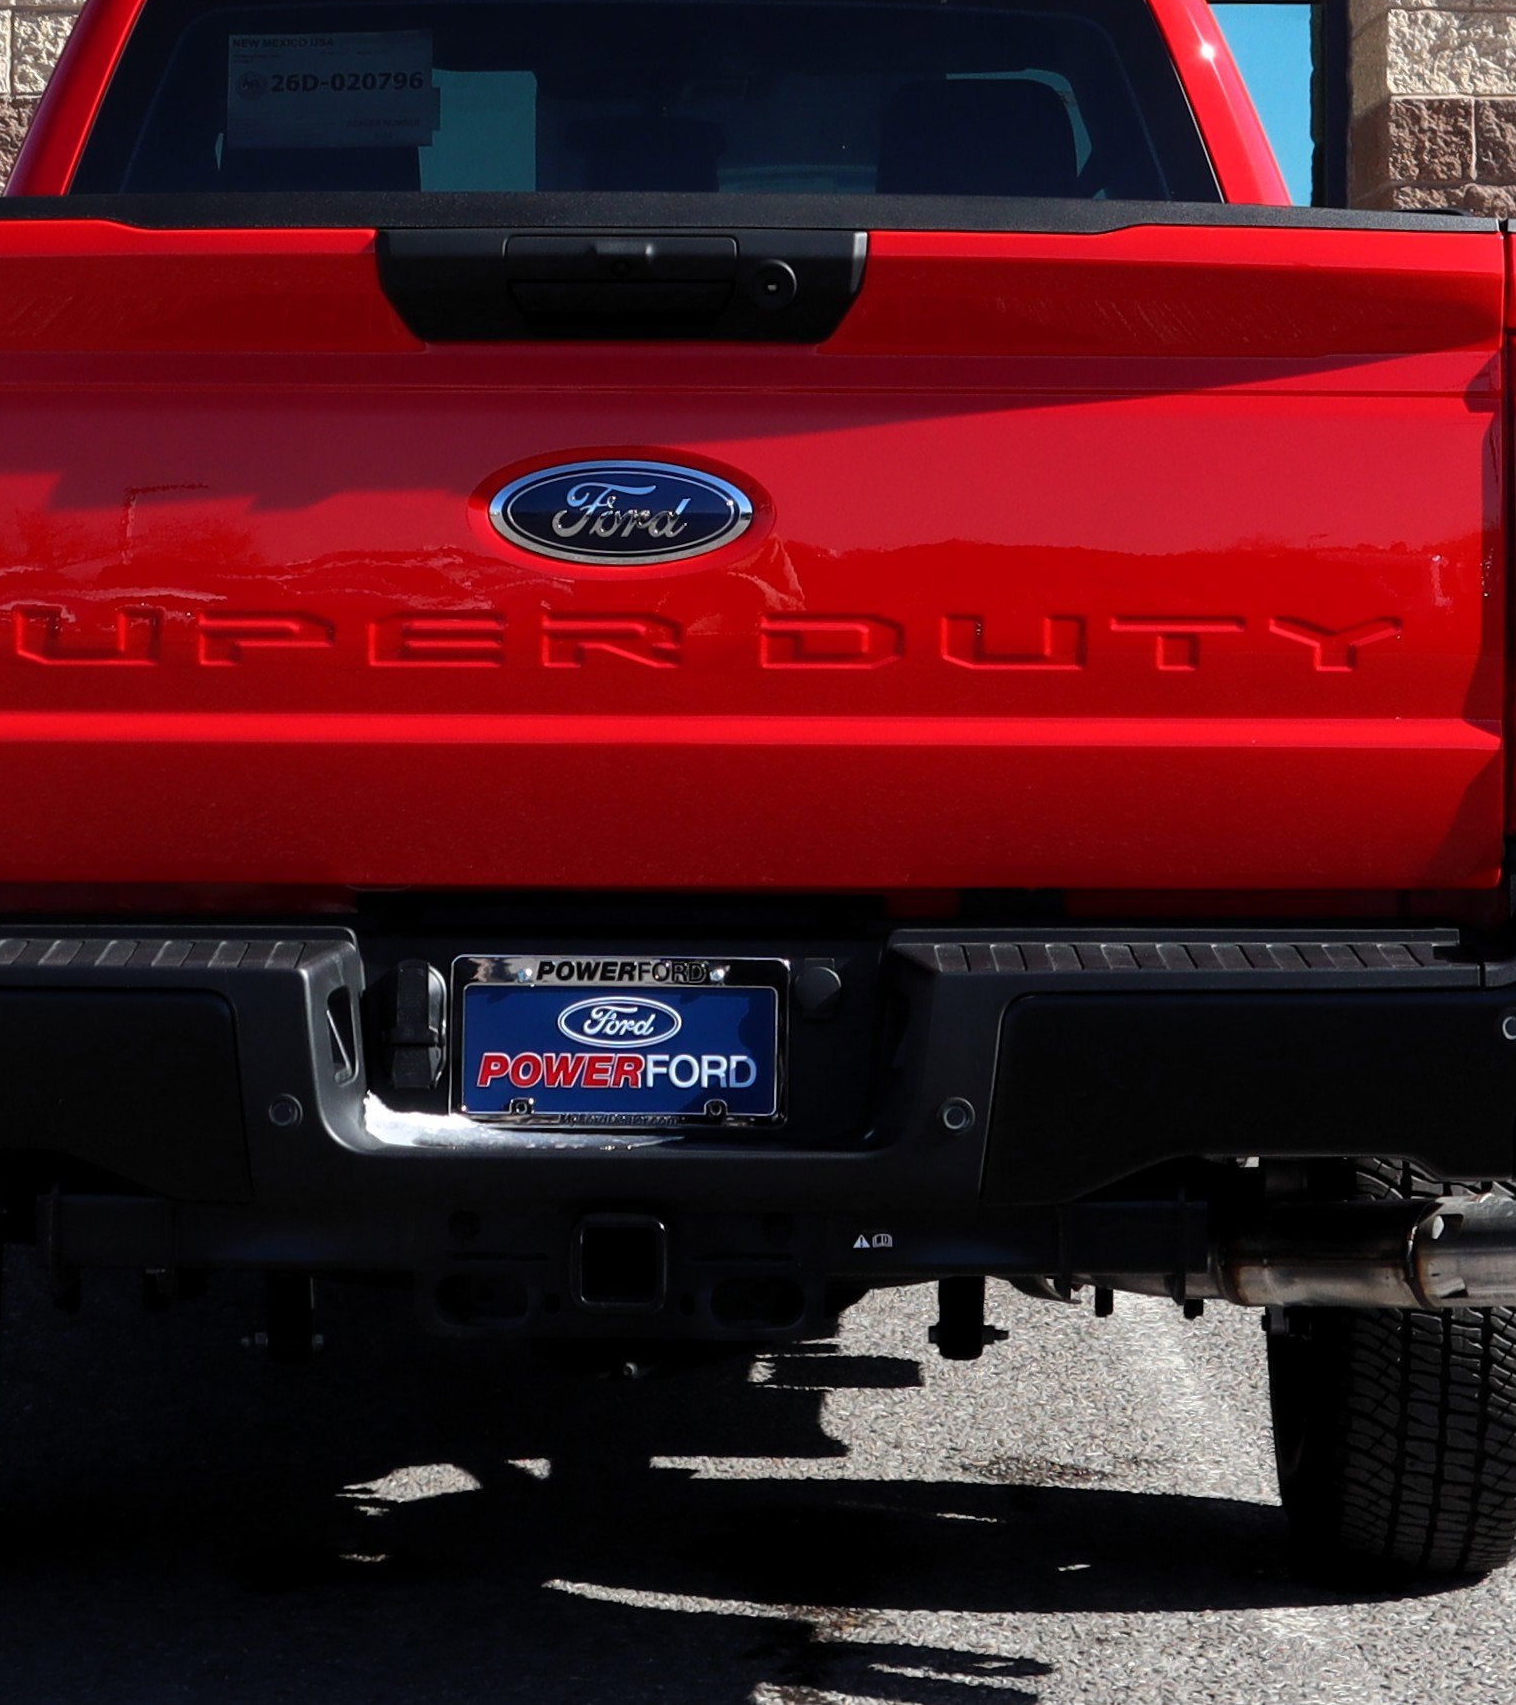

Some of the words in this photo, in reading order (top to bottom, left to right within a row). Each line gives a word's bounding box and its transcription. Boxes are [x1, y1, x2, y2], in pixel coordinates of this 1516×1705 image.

[232, 38, 259, 48] NEW
[263, 37, 307, 48] MEXICO
[310, 37, 334, 48] USA
[270, 71, 424, 93] 26D-020796
[552, 483, 690, 538] Ford
[757, 614, 1404, 673] DUTY
[537, 961, 707, 982] POWERFORD
[584, 1005, 655, 1036] Ford
[478, 1052, 757, 1088] POWERFORD
